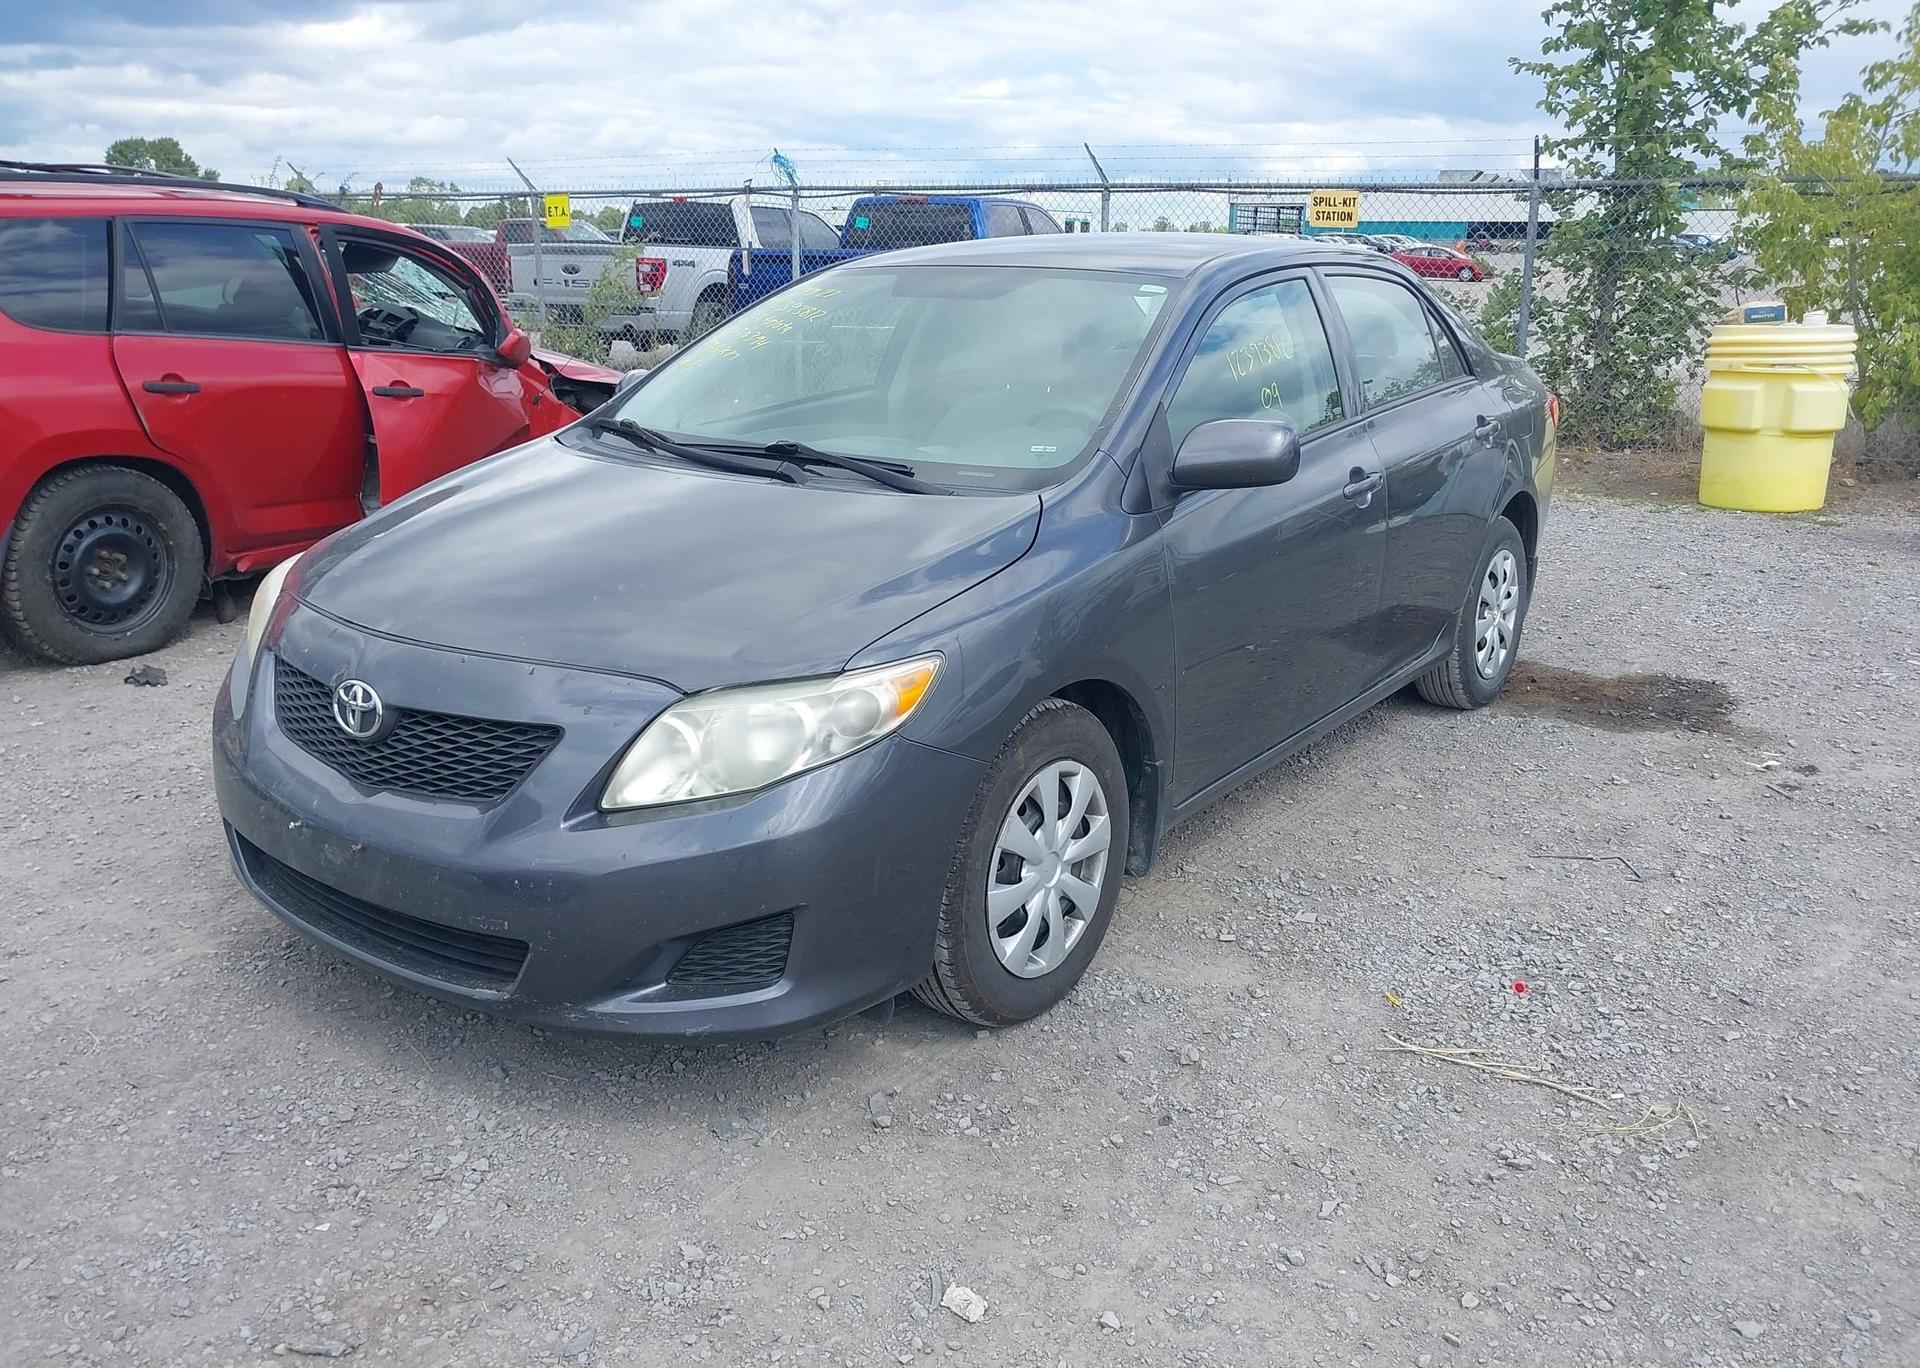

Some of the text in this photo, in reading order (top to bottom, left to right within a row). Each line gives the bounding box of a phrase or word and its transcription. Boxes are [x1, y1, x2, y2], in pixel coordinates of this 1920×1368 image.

[1313, 197, 1357, 207] SPILL-KIT
[548, 206, 568, 217] E.T.A.
[1315, 211, 1353, 221] STATION
[1261, 382, 1284, 410] 09
